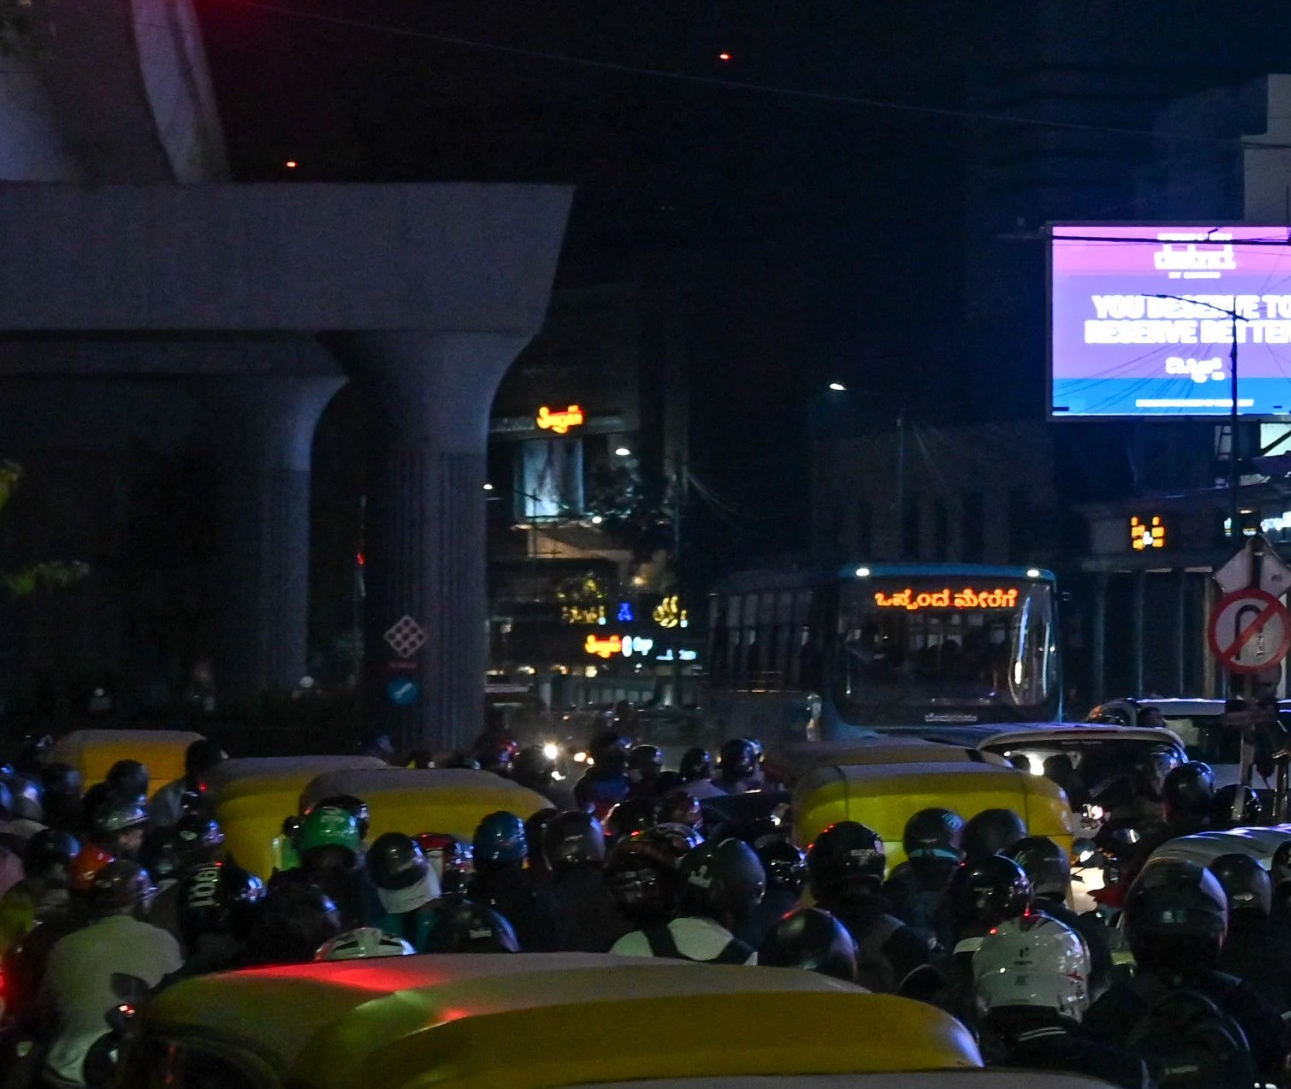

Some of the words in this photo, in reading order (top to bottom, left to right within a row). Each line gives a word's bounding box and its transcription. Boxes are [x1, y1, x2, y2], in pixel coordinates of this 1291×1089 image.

[1092, 295, 1146, 319] YOU
[875, 588, 950, 610] ಒಪ್ಪಂದ
[953, 587, 1018, 608] ಮೇರೆಗೆ
